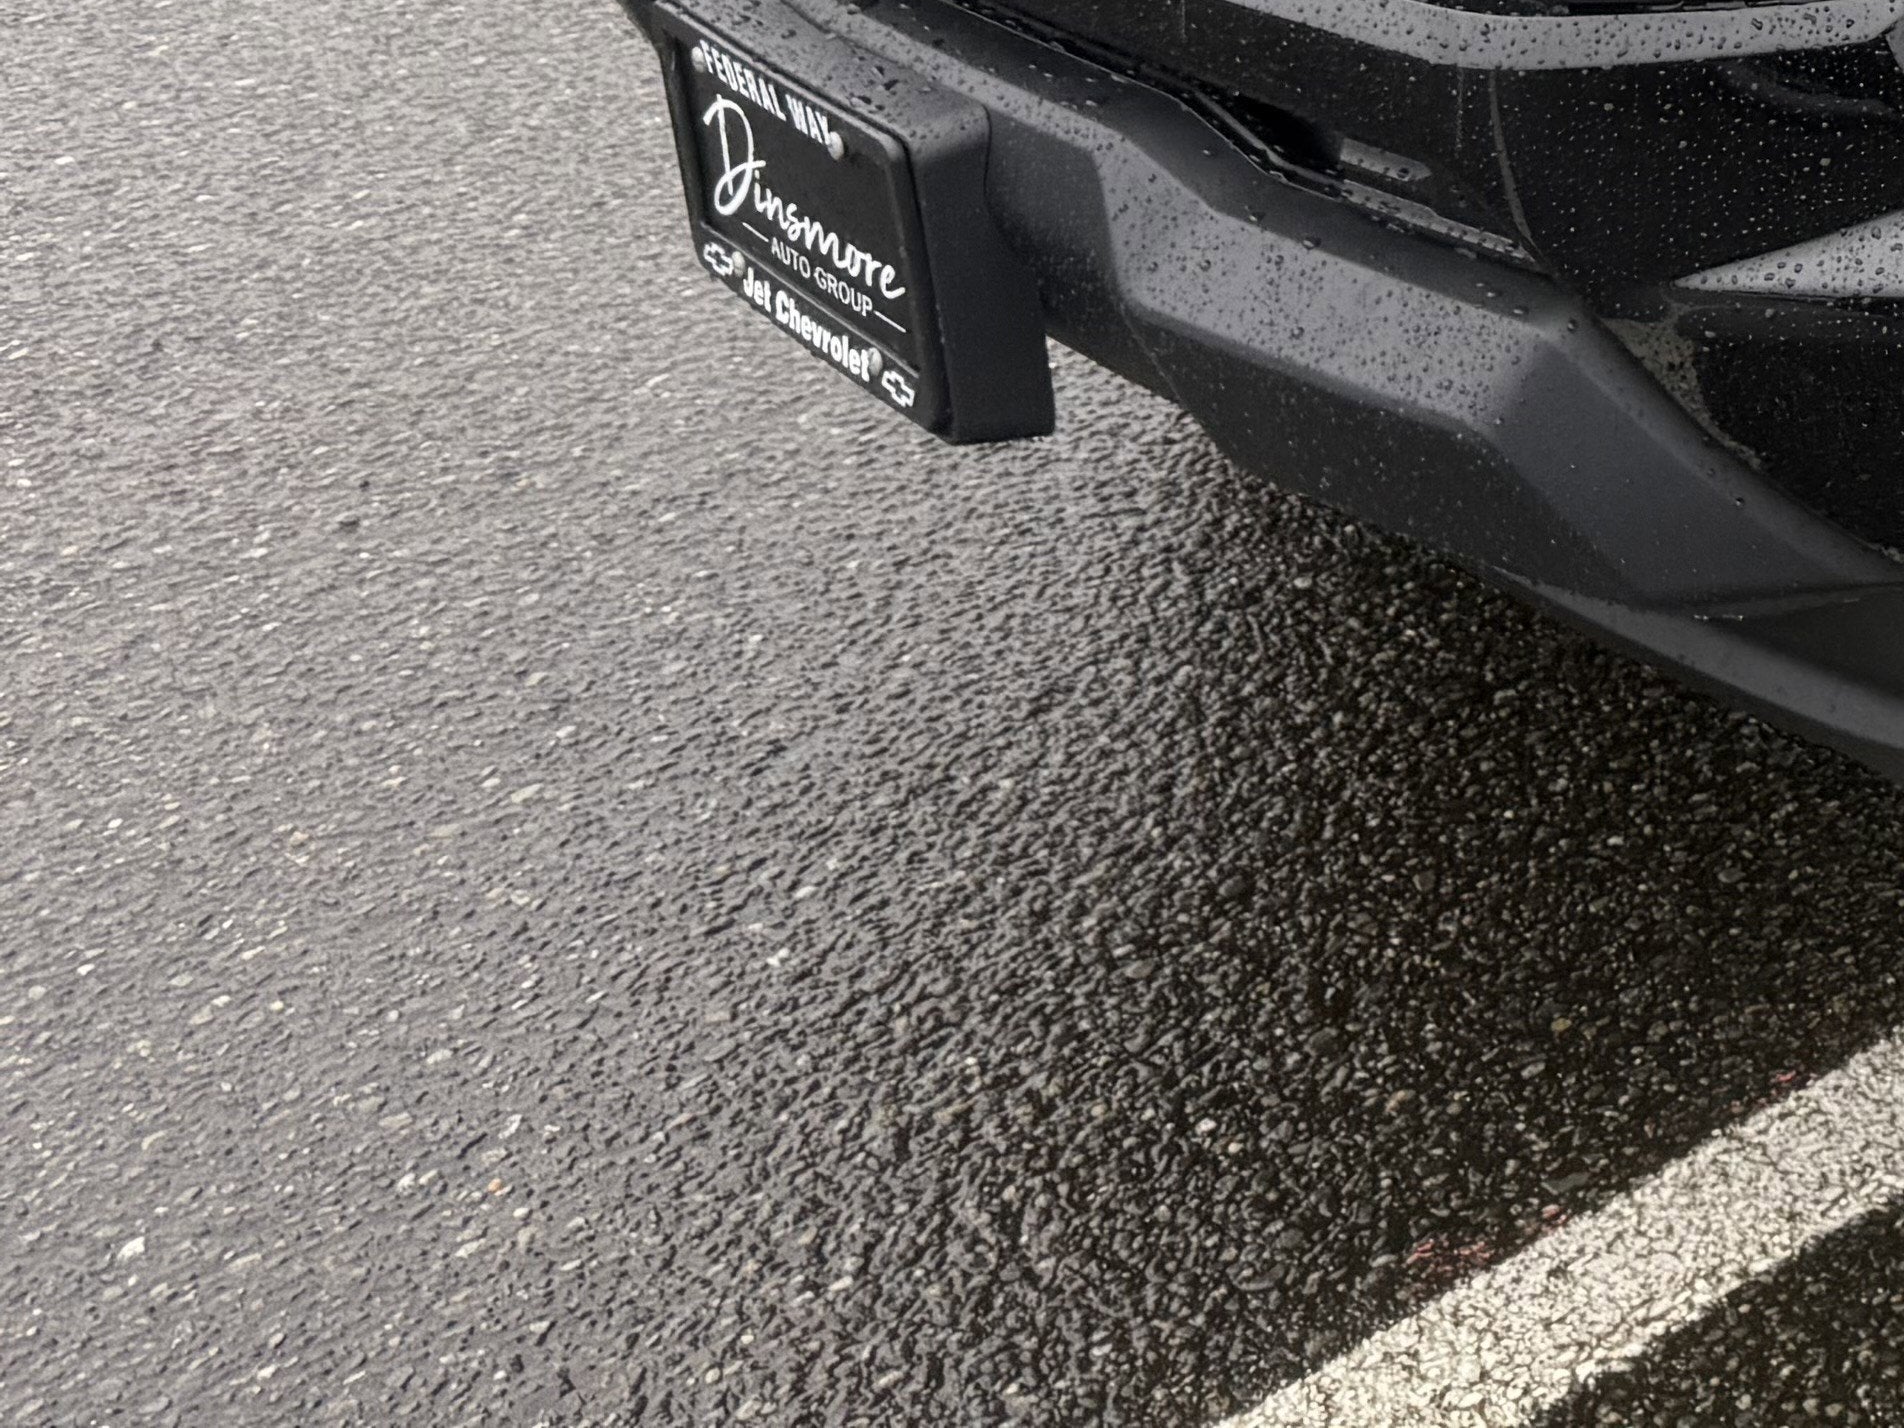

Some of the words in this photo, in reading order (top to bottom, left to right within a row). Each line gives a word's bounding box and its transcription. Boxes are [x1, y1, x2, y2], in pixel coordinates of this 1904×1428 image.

[700, 39, 786, 121] FEDERAL
[786, 97, 833, 145] WAY
[703, 93, 906, 300] Dinsmore
[742, 265, 772, 313] Jet
[776, 290, 871, 383] Chevrolet
[771, 238, 811, 280] AUTO
[814, 269, 873, 317] GROUP
